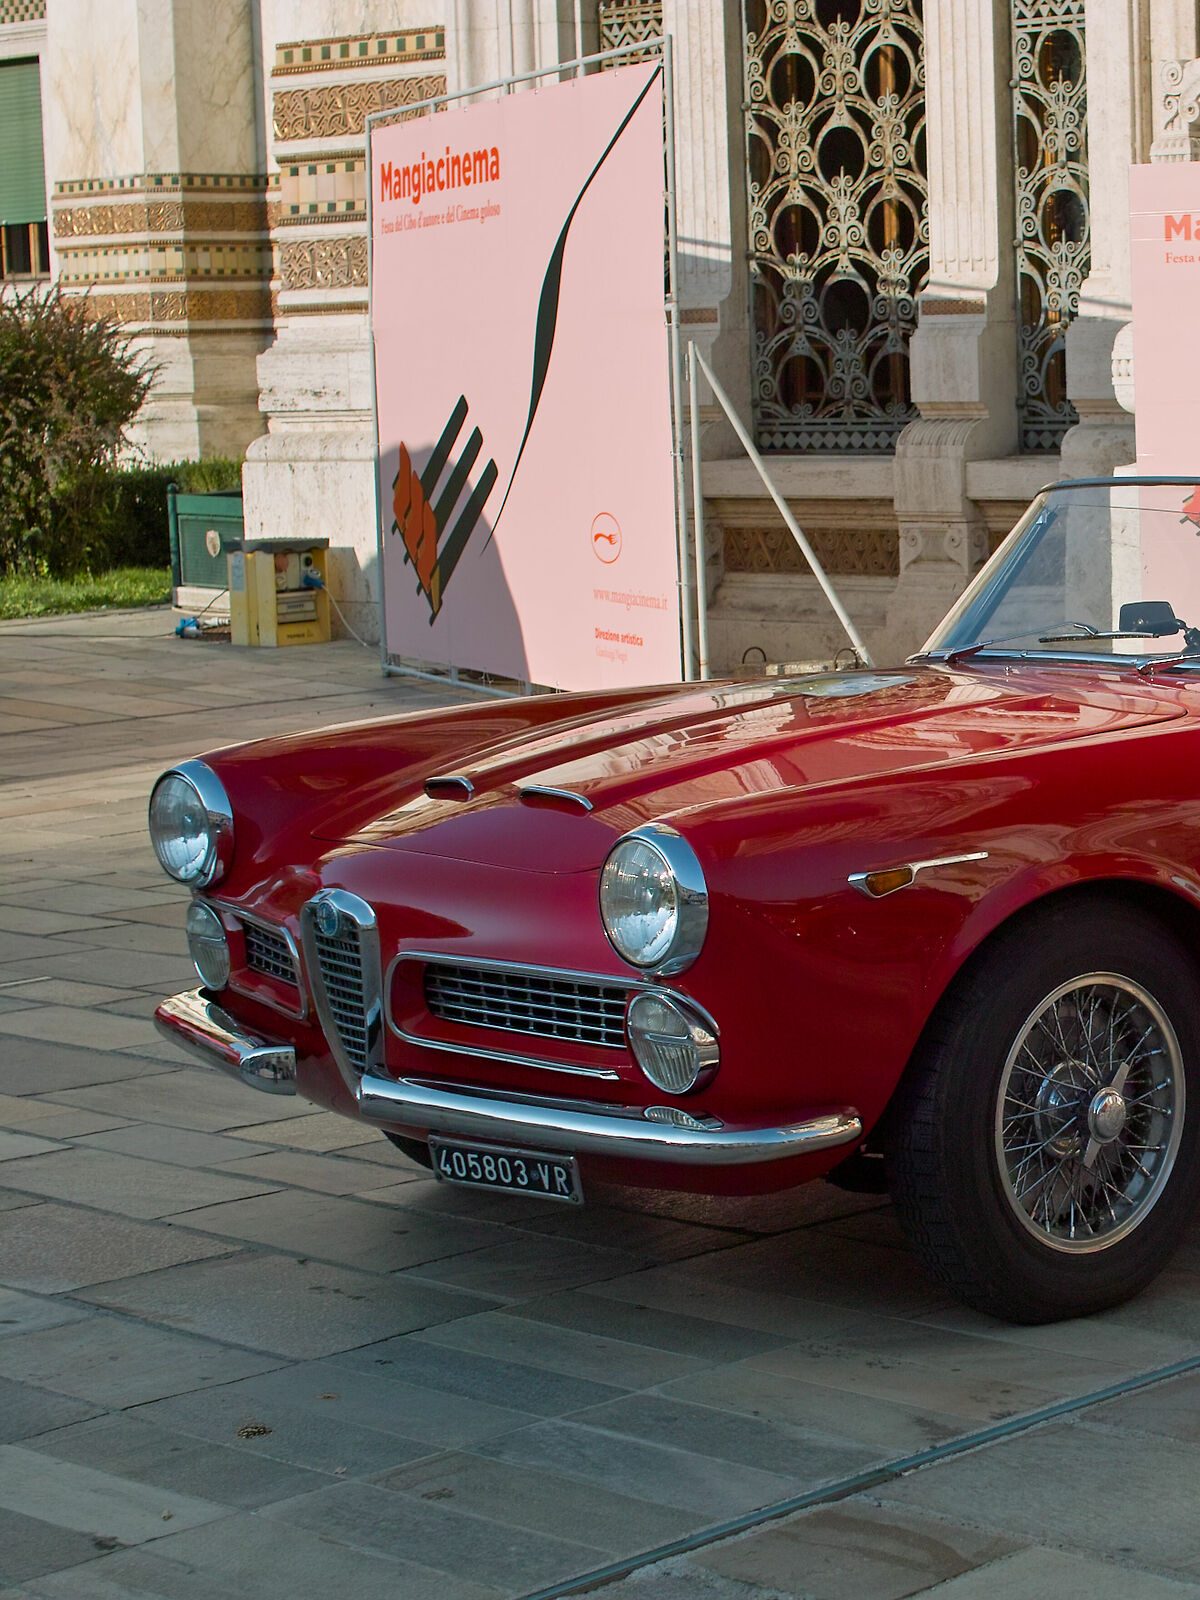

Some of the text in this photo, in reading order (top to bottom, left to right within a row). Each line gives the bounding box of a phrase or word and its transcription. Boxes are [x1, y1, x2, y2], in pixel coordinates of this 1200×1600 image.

[381, 146, 500, 205] Mangiacinema
[446, 205, 455, 224] del
[1165, 251, 1195, 264] Festa
[593, 588, 668, 611] www.mangiacinema.it
[595, 627, 643, 647] Direzione artistica
[440, 1149, 569, 1194] 405803 VR
